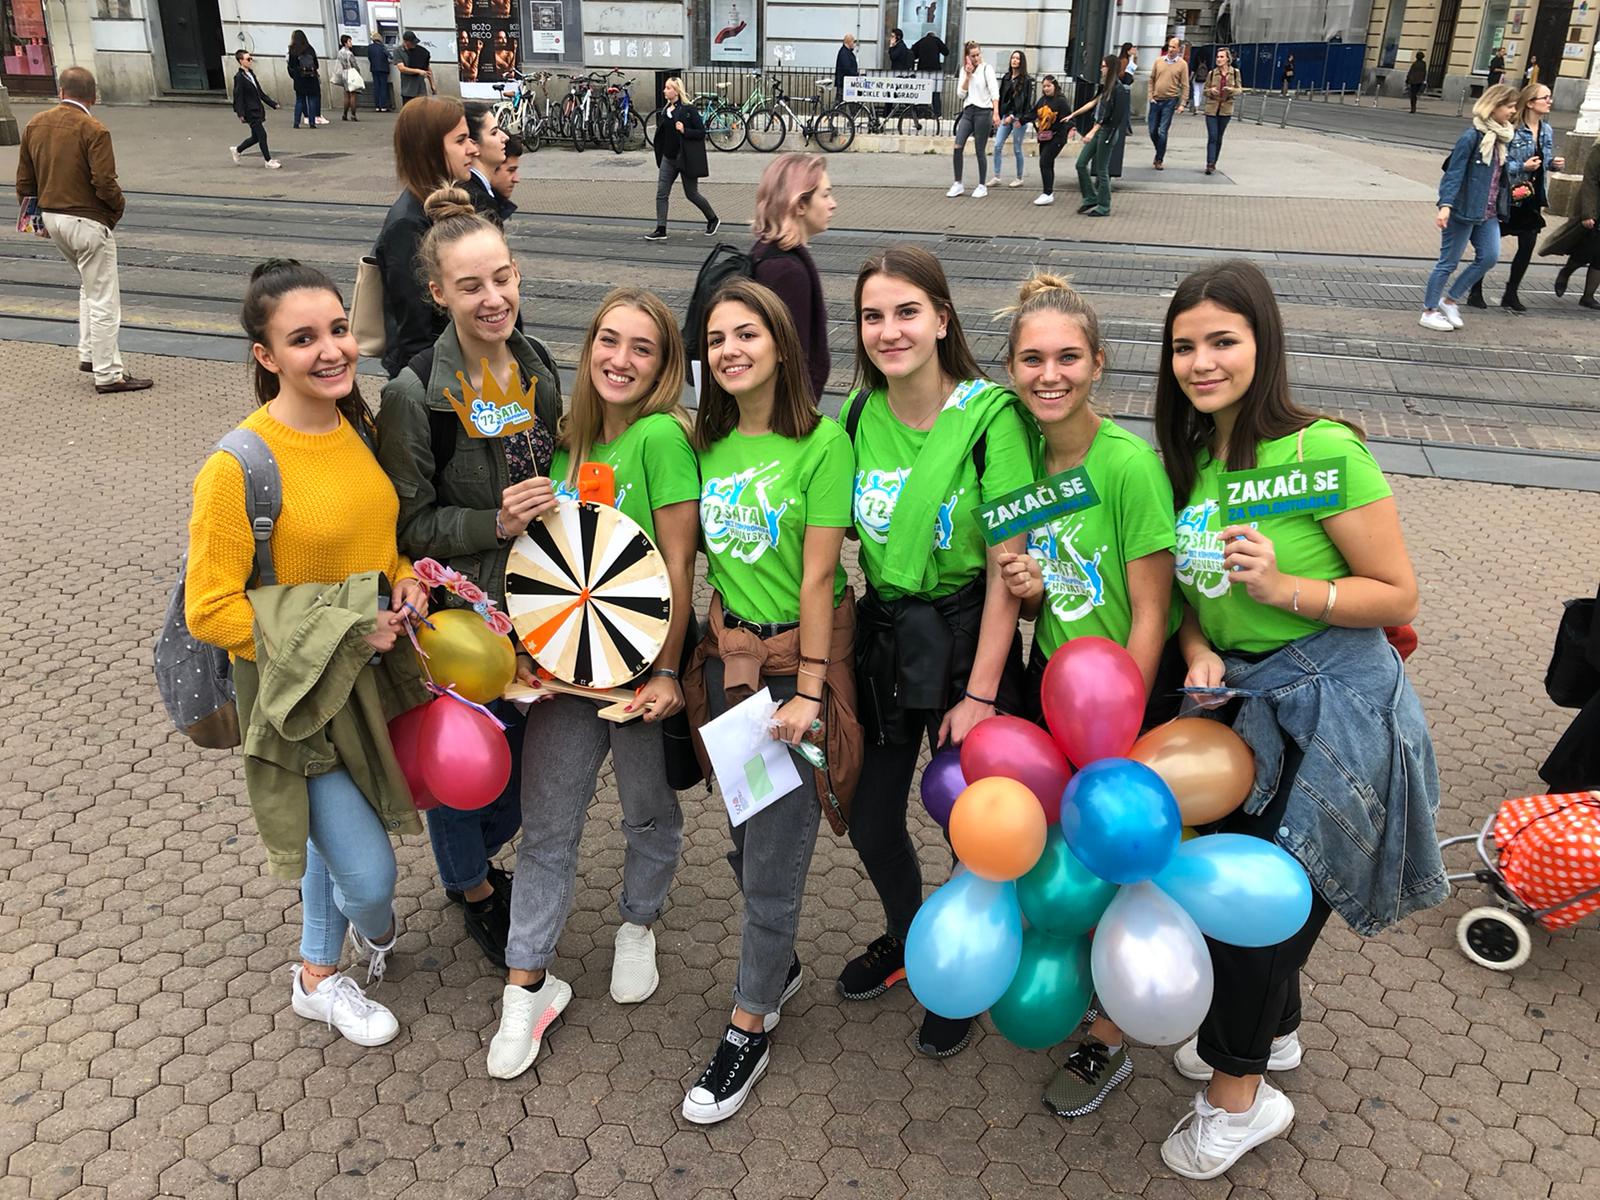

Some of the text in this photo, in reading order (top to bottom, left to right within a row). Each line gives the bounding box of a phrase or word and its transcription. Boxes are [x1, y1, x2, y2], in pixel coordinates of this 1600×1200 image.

[480, 403, 521, 426] 72 SATA
[1227, 469, 1339, 505] ZAKAČI SE
[704, 503, 758, 525] 72 SATA
[865, 496, 887, 519] 72
[982, 485, 1057, 530] ZAKAČI
[1060, 477, 1086, 498] SE
[1228, 494, 1340, 521] ZA VOLONTIRANJE
[1191, 532, 1223, 551] SATA
[1192, 560, 1223, 571] HRVATS
